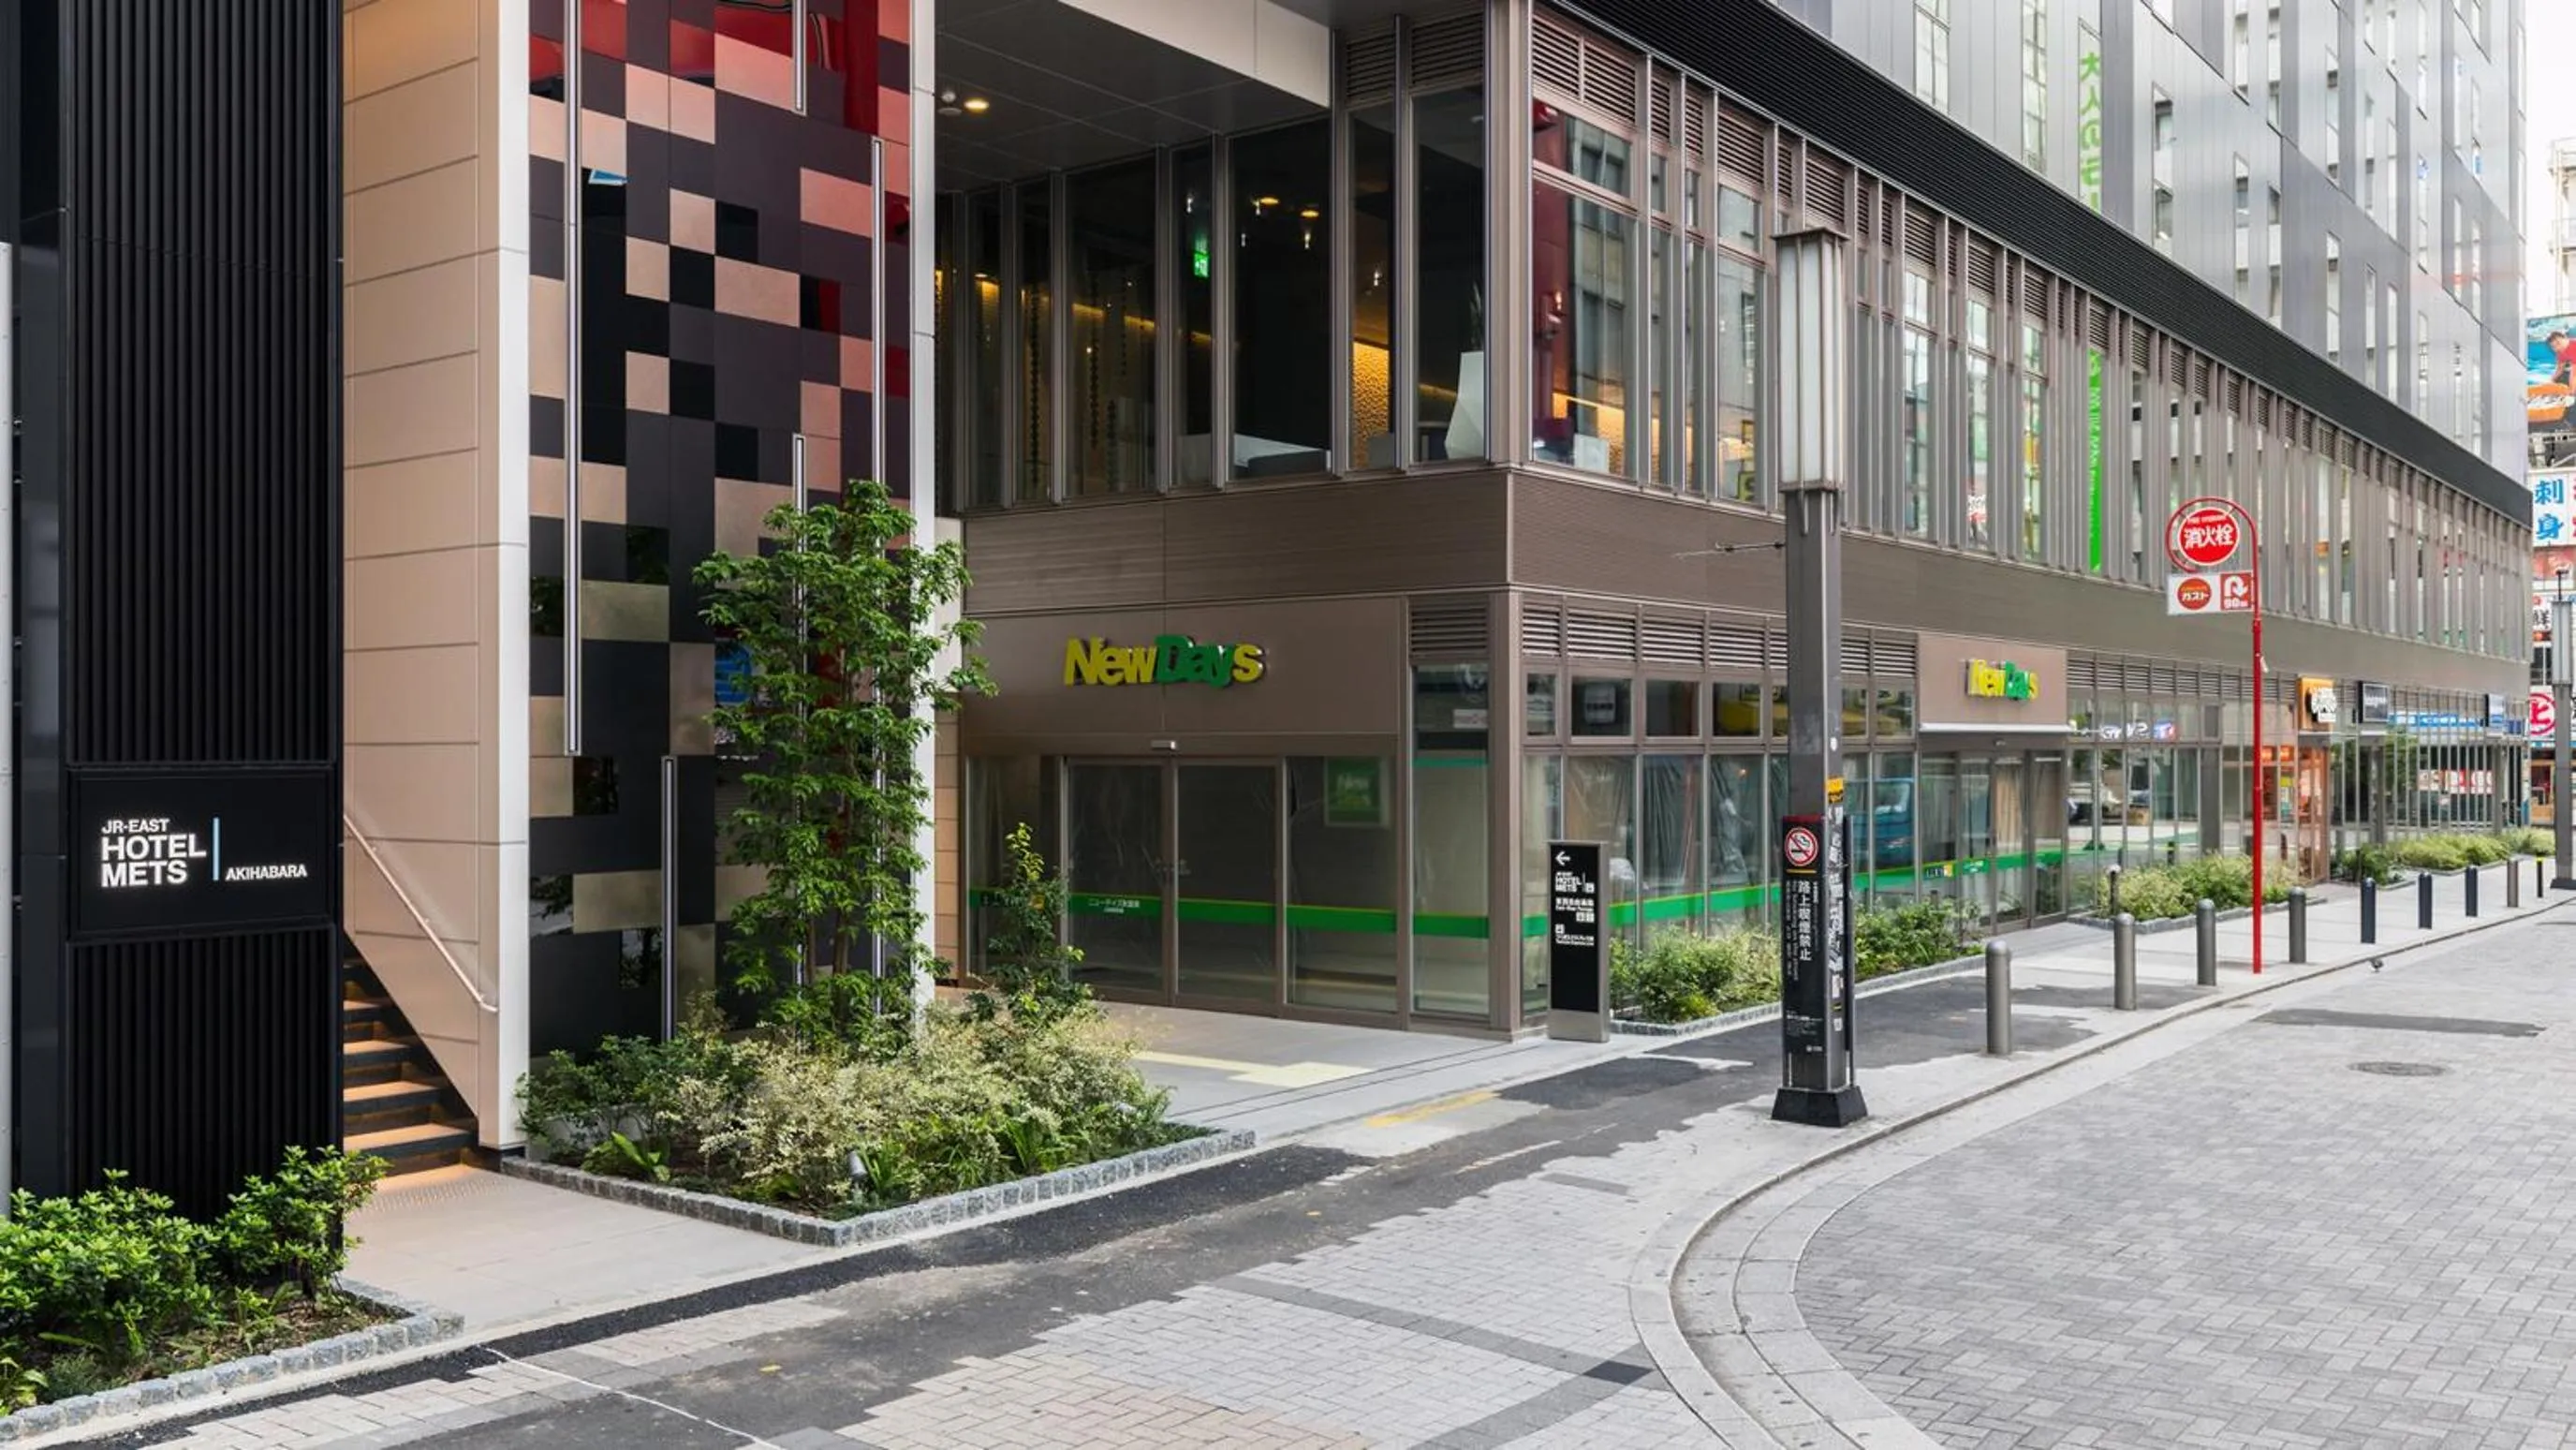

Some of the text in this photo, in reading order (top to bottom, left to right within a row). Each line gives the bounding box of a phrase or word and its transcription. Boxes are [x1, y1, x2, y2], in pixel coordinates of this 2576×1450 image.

[2535, 479, 2564, 540] 刺身
[2184, 524, 2234, 550] 消火栓
[1064, 634, 1264, 688] NewDays
[1965, 658, 2039, 700] NewDays
[101, 819, 169, 834] JR-EAST
[101, 834, 206, 861] HOTEL
[101, 859, 187, 887] METS
[225, 864, 307, 881] AKIHABARA
[1799, 880, 1813, 961] 路上喫煙禁止
